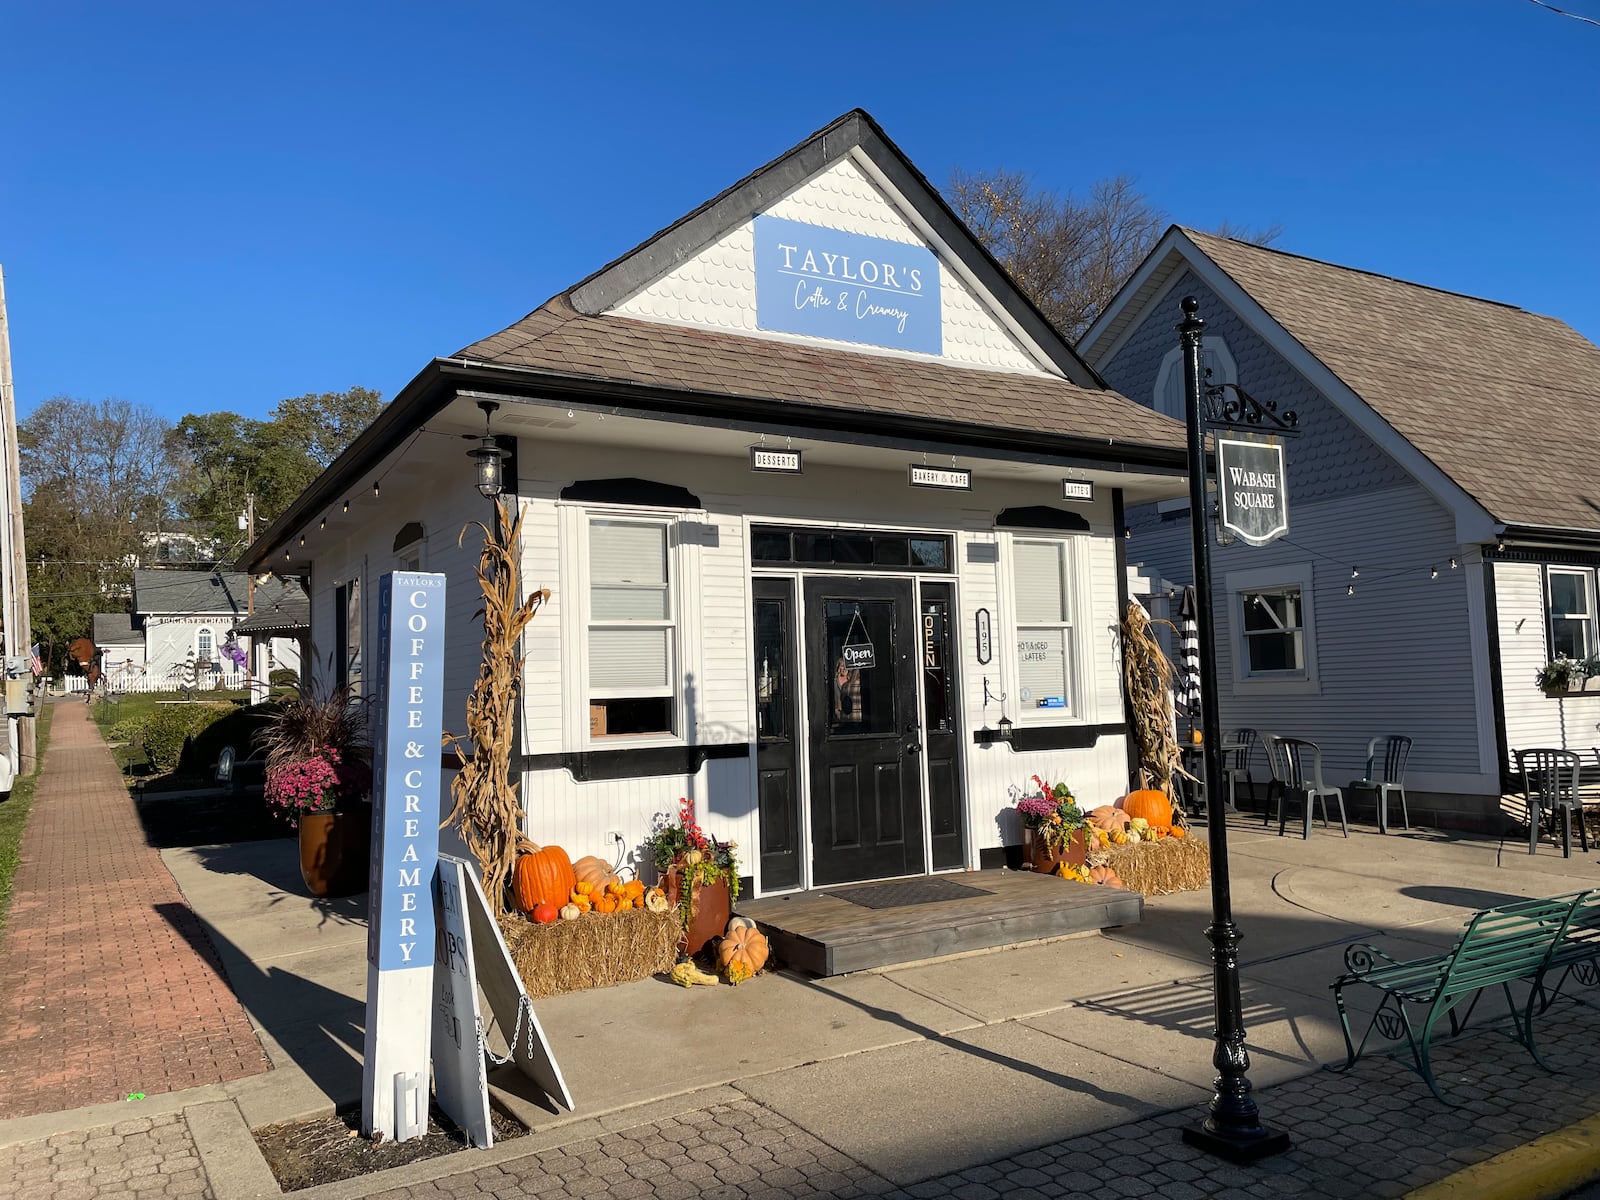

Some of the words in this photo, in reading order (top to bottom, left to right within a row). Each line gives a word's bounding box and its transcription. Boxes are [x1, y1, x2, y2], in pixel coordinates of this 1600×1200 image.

[777, 243, 922, 291] TAYLOR'S
[795, 280, 831, 310] Coffee
[837, 292, 848, 311] &
[855, 290, 909, 333] Creamery
[757, 454, 796, 467] DESSERTS
[914, 471, 938, 482] BAKERY
[950, 474, 966, 485] CAFE
[1229, 466, 1276, 488] WABASH
[1234, 491, 1275, 509] SQUARE
[397, 577, 442, 586] TAYLOR'S
[924, 616, 935, 667] OPEN
[407, 590, 427, 728] COFFEE
[844, 648, 873, 663] Open
[404, 741, 424, 759] &
[398, 770, 422, 961] CREAMERY
